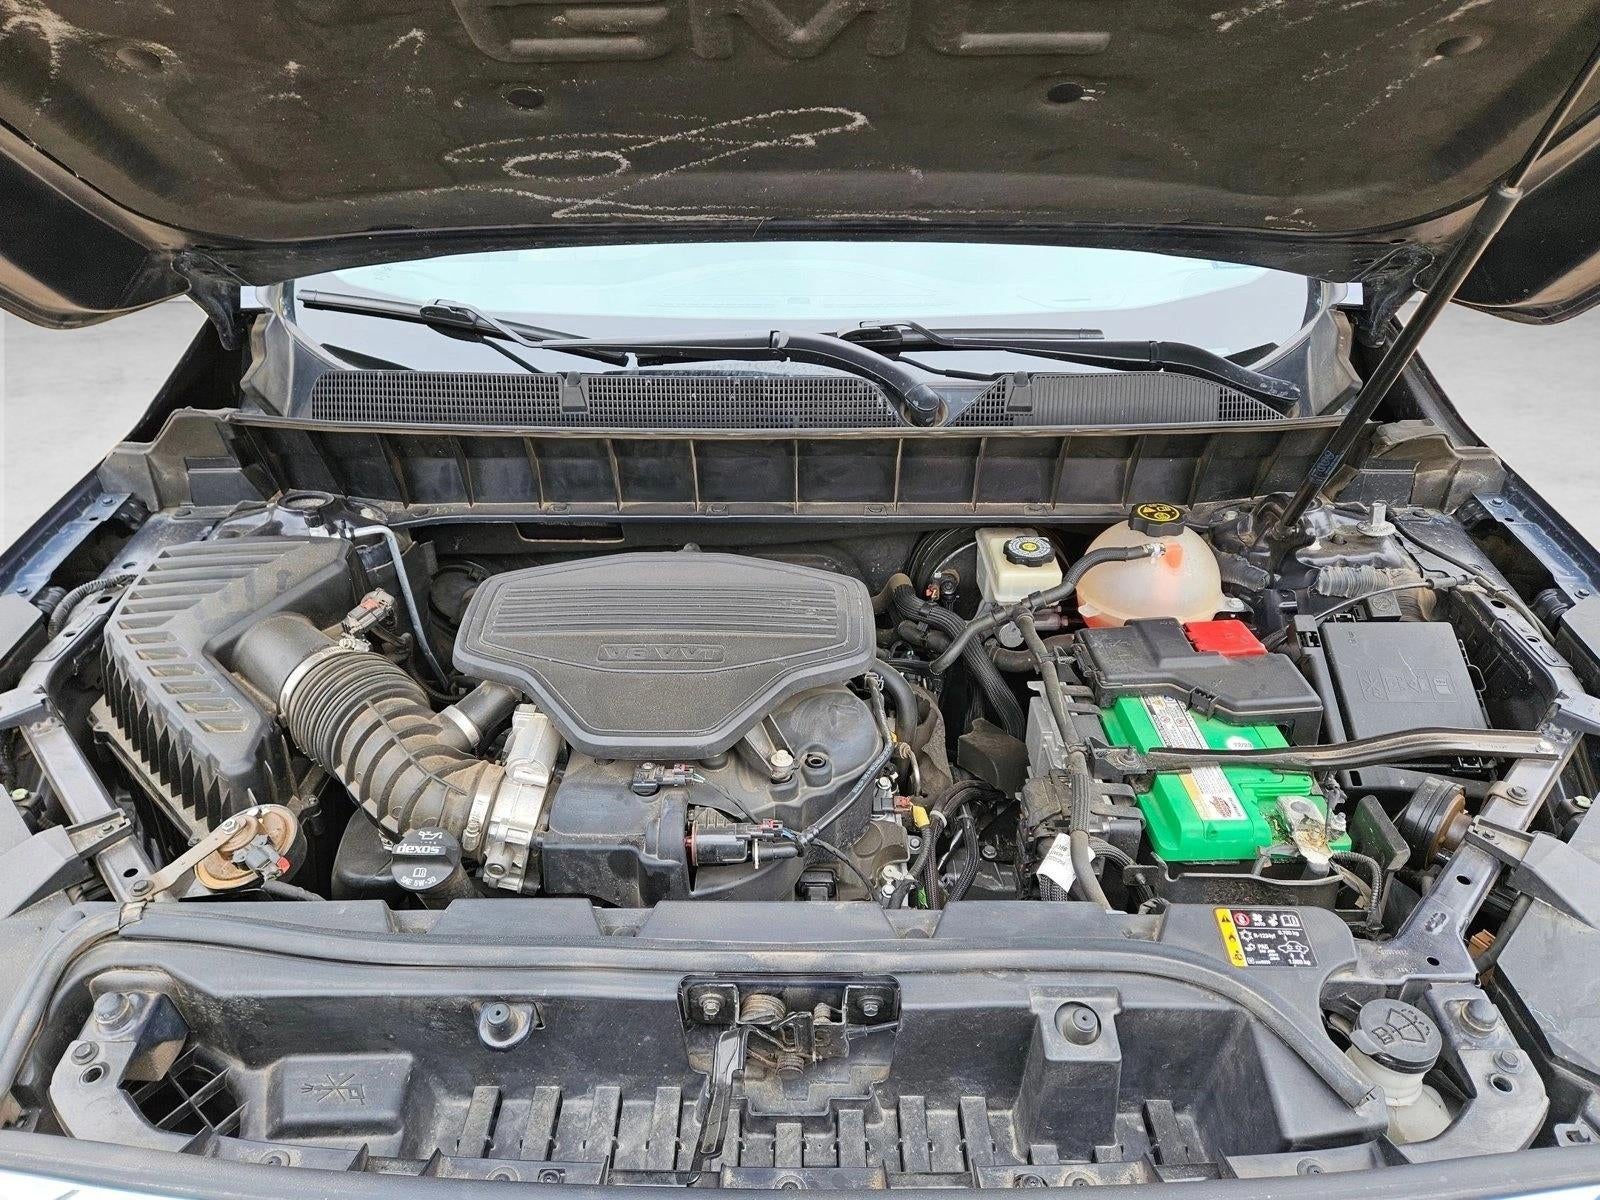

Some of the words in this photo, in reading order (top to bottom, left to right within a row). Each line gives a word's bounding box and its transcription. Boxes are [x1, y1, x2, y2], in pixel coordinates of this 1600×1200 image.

[397, 844, 441, 854] dexos
[401, 876, 413, 885] SAE
[414, 876, 436, 887] 5W-30
